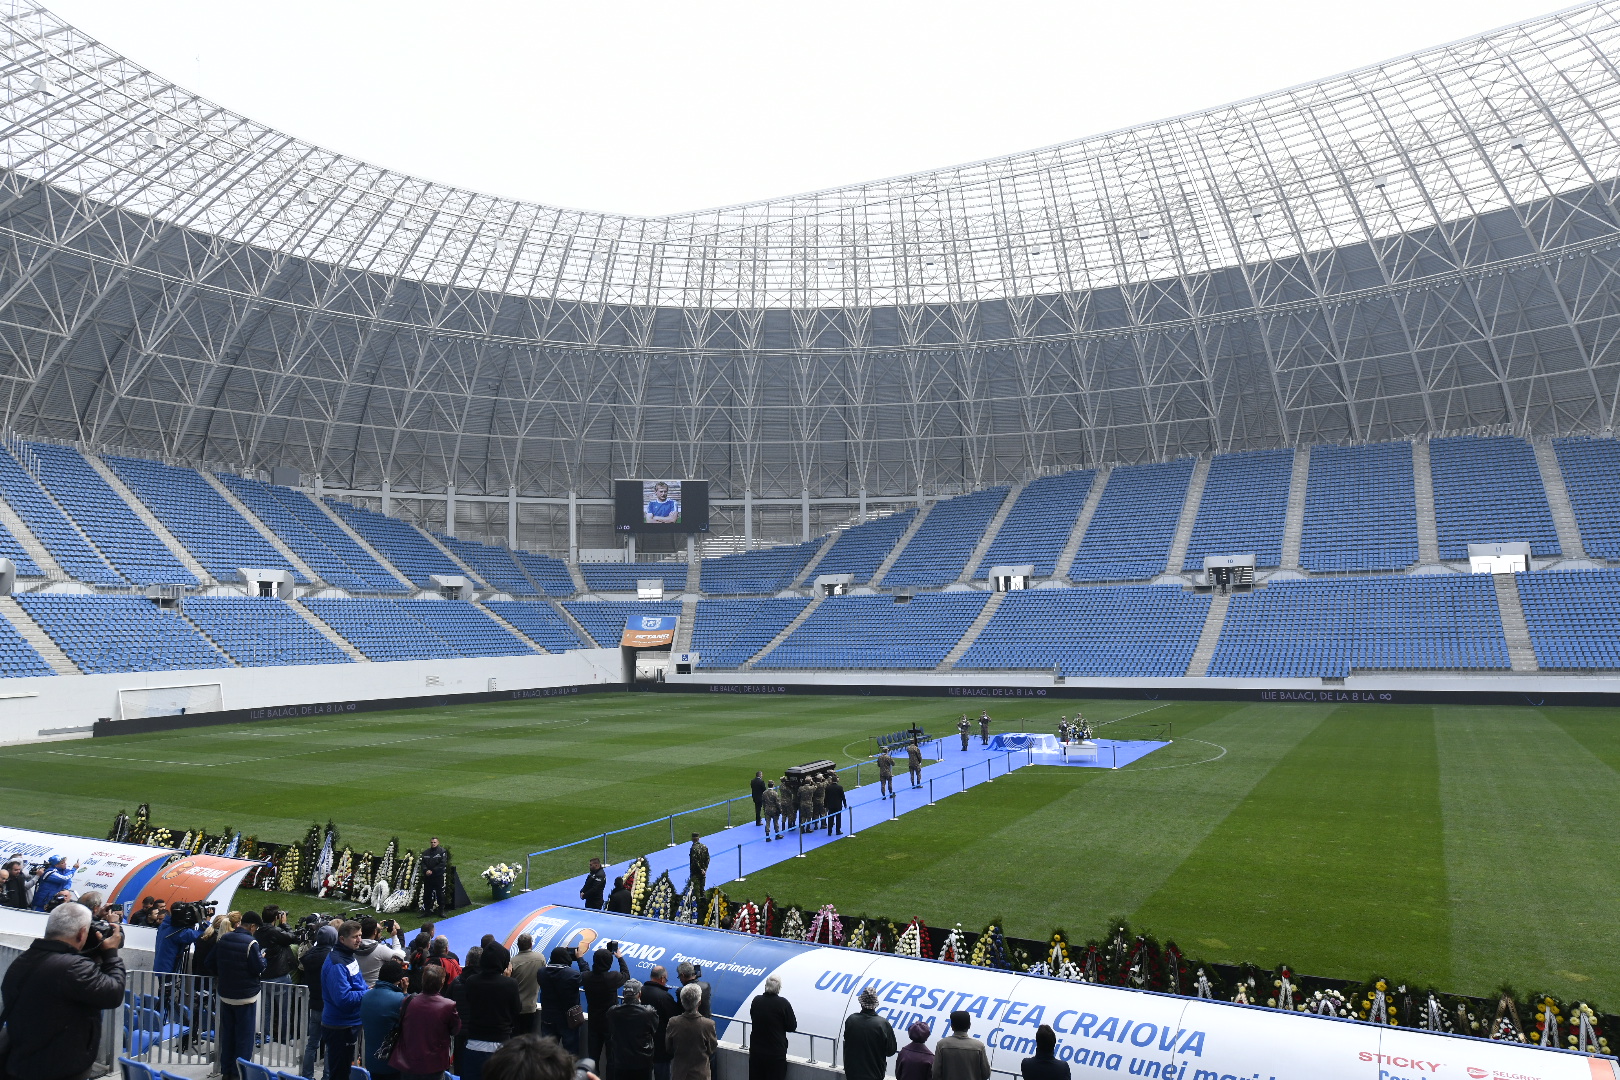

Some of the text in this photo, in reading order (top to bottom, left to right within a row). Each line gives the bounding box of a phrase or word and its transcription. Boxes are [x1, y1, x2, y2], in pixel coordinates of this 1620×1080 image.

[1261, 692, 1277, 700] ILIE
[1280, 692, 1316, 701] BALACI,
[1320, 692, 1333, 700] DE
[1336, 692, 1348, 700] LA
[267, 707, 299, 717] BALACI,
[302, 706, 312, 714] DE
[314, 705, 324, 714] LA
[326, 705, 331, 713] 8
[334, 704, 344, 712] LA
[184, 866, 229, 879] BETANO
[671, 952, 767, 976] Partener principal
[814, 970, 1206, 1057] UNIVERSITATEA CRAIOVA
[986, 1027, 1123, 1072] Camioana
[1358, 1051, 1441, 1072] STICKY
